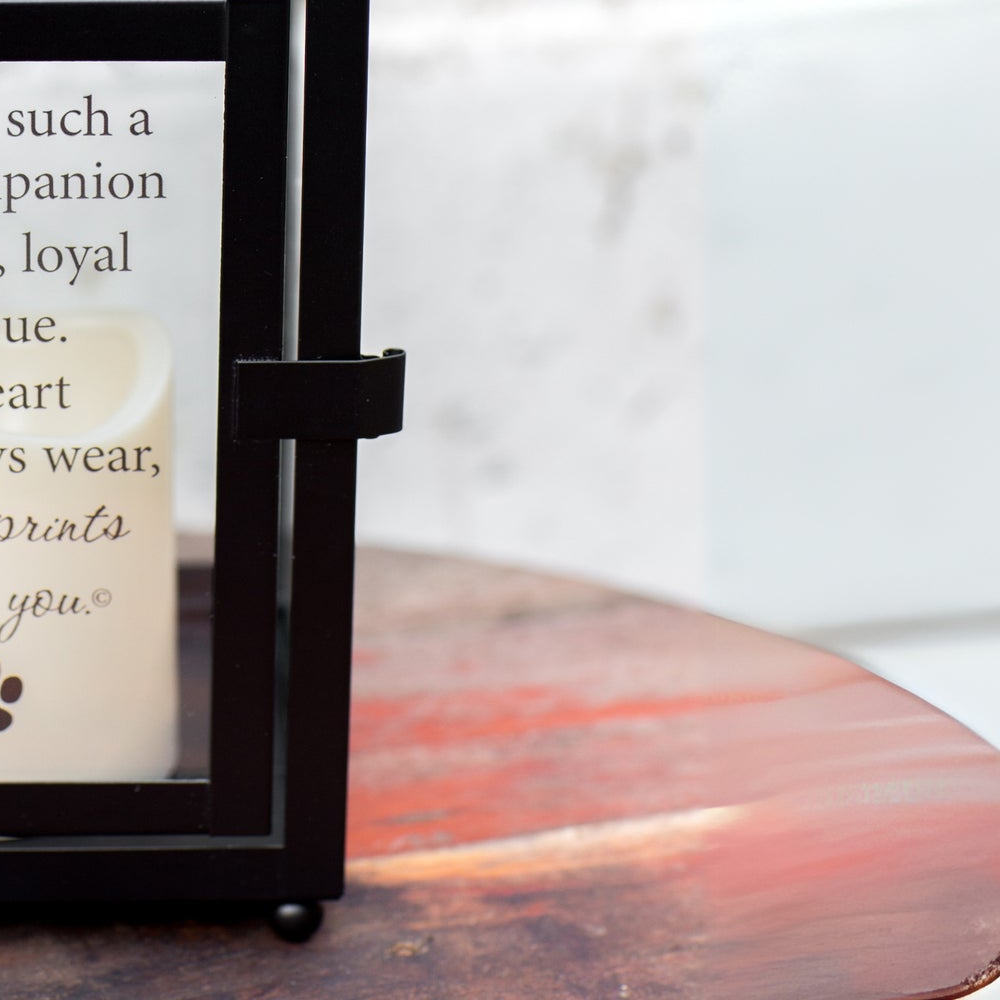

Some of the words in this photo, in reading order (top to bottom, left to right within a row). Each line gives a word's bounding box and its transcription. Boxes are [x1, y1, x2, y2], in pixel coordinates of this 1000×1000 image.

[7, 94, 112, 137] such
[130, 109, 153, 136] a
[22, 231, 132, 285] loyal
[43, 446, 160, 477] wear,
